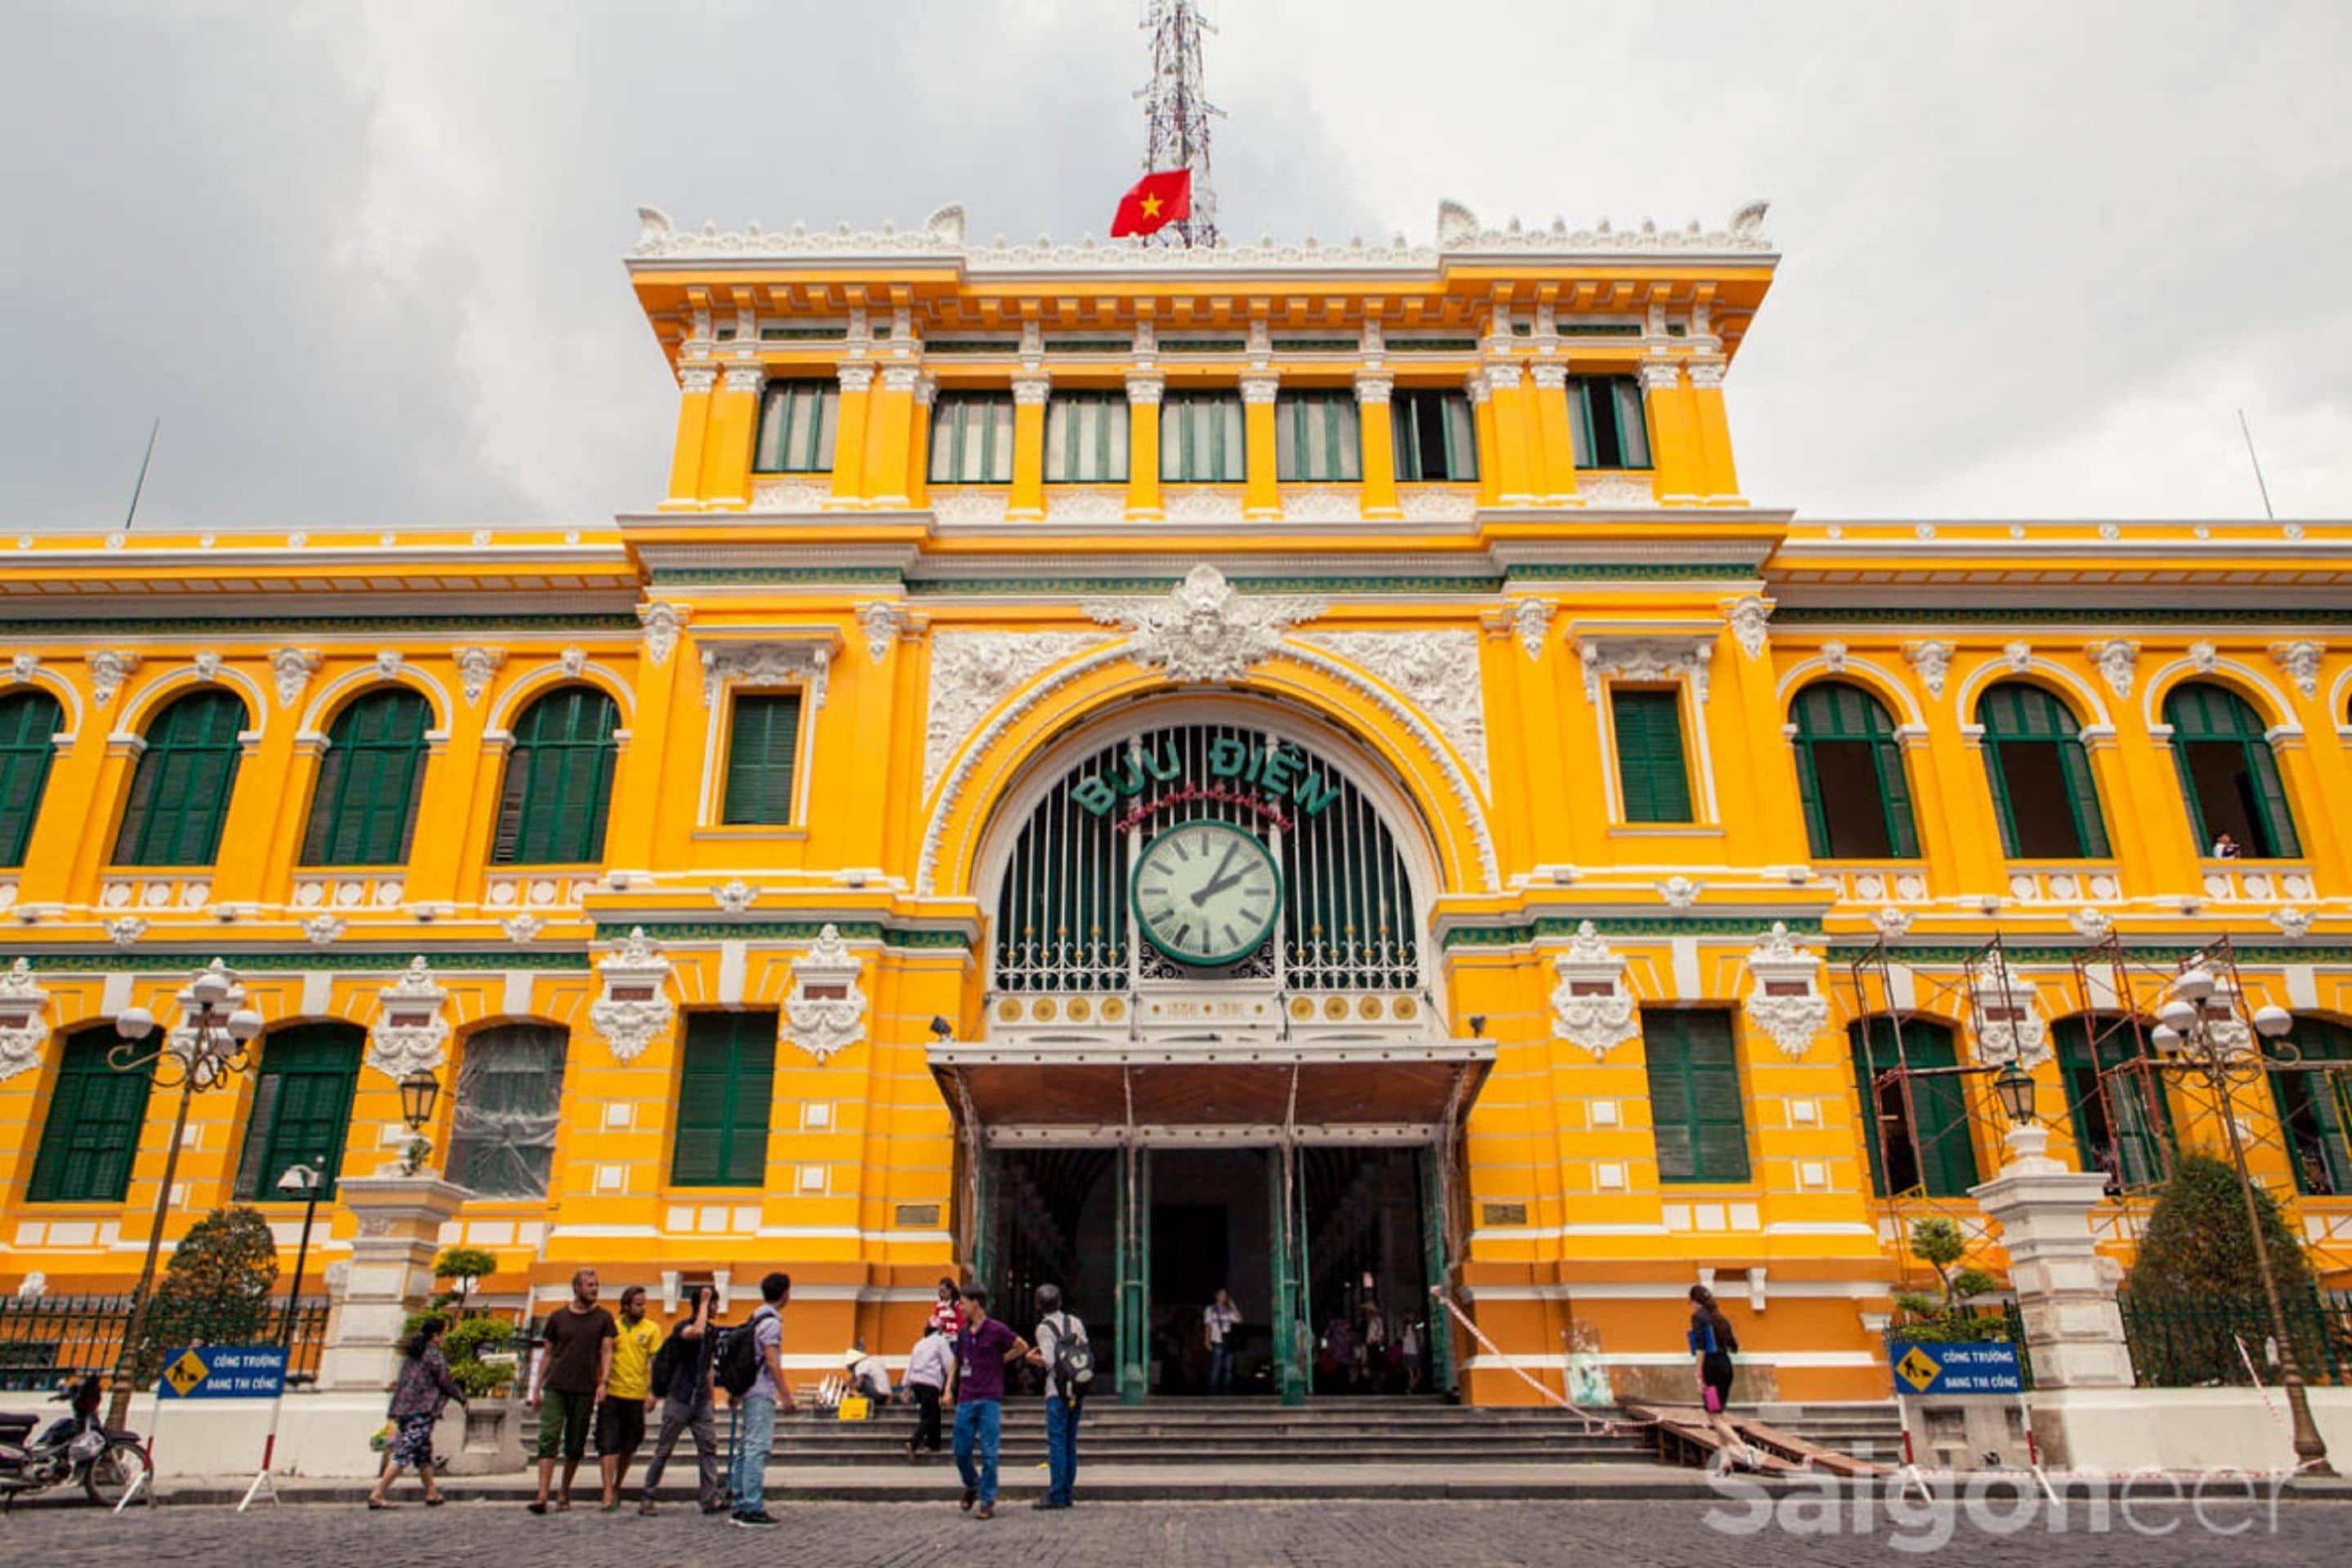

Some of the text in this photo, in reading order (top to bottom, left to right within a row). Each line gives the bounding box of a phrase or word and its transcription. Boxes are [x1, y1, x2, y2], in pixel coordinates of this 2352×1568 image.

[1209, 737, 1340, 817] ĐIỆN
[213, 1352, 241, 1368] CÔNG
[1941, 1348, 1971, 1364] CÔNG
[252, 1374, 278, 1390] CÔNG
[1990, 1374, 2018, 1388] CÔNG
